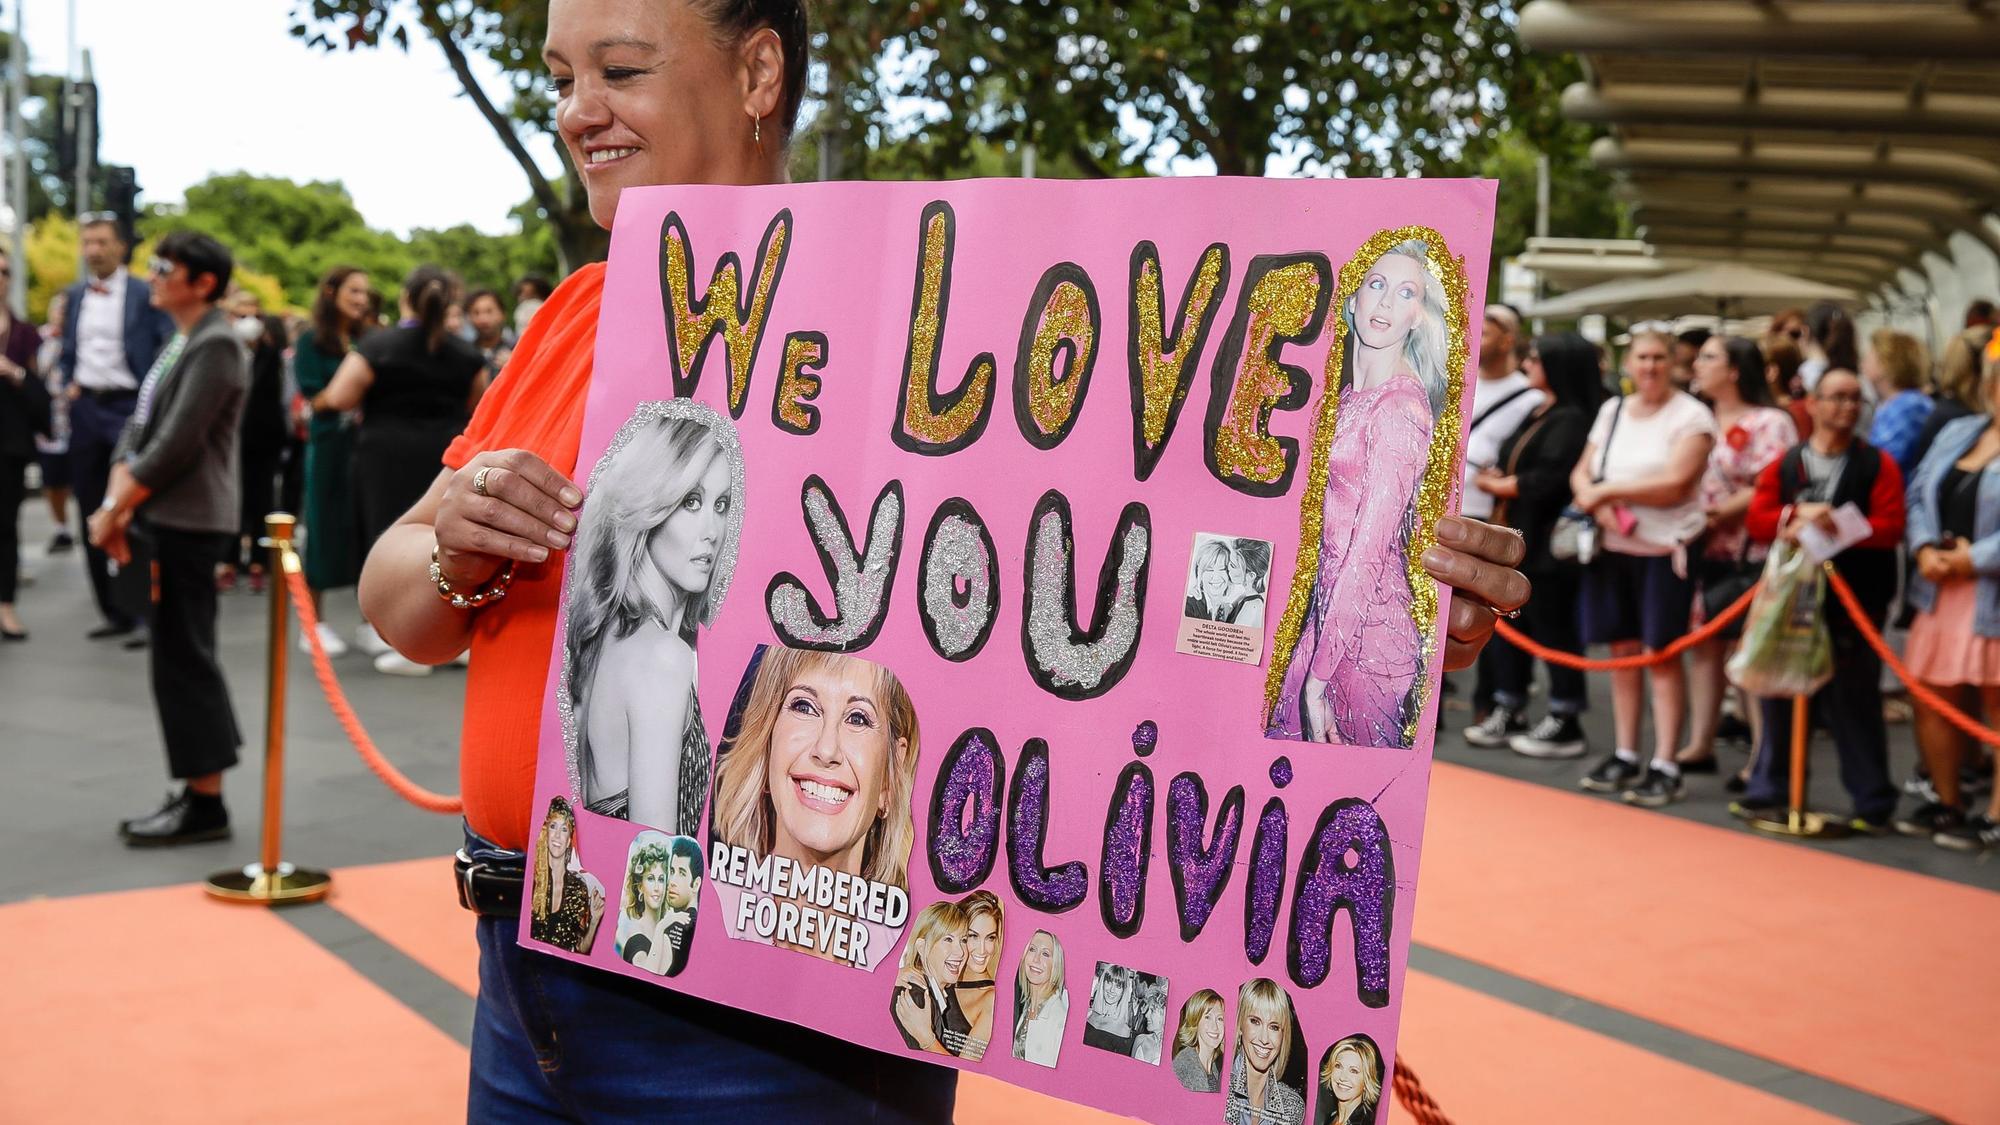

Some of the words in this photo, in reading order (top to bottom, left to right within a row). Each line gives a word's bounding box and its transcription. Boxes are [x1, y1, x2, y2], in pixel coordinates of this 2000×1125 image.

[891, 200, 1331, 497] LOVE
[764, 474, 1151, 700] YOU
[710, 841, 910, 928] REMEMBERED
[736, 891, 870, 966] FOREVER
